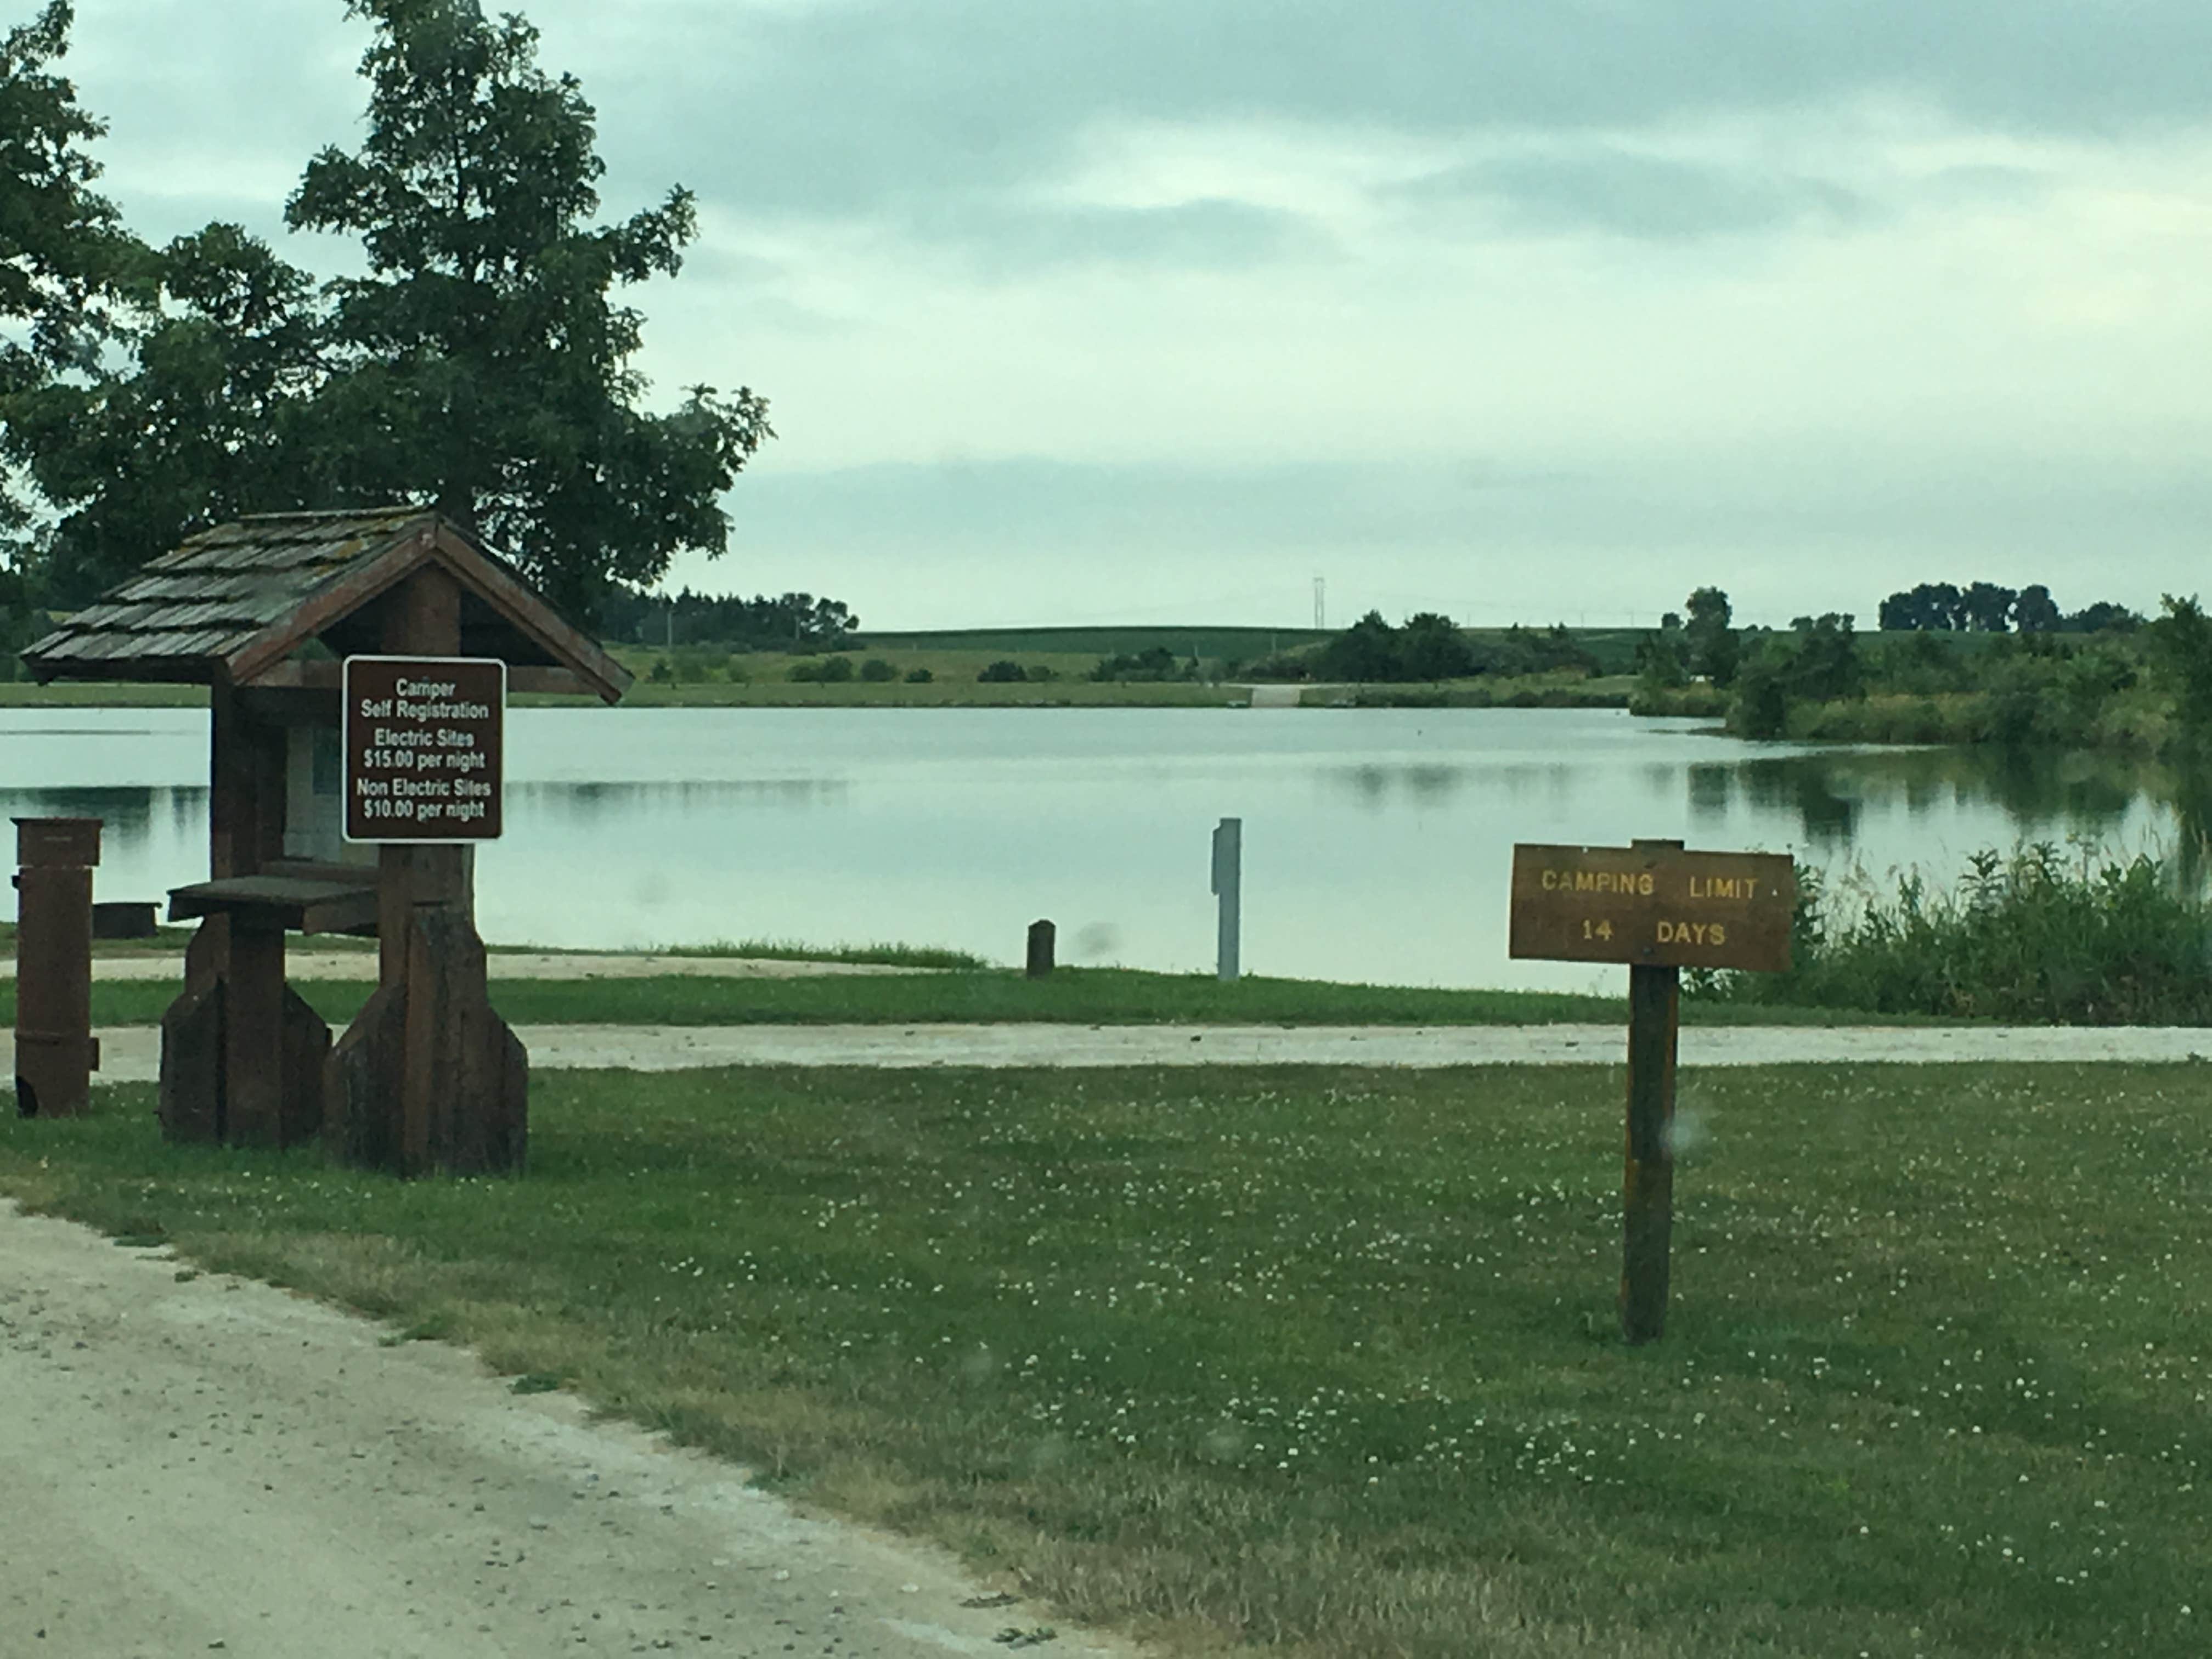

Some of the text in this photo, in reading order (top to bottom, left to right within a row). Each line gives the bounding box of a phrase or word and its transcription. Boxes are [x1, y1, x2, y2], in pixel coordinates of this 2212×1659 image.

[396, 678, 456, 700] Camper
[361, 699, 489, 722] Self Registration
[375, 729, 475, 747] Electric Sites
[364, 749, 486, 772] $15.00 per night
[357, 778, 492, 796] Non Electric Sites
[364, 799, 484, 822] $10.00 per night
[1542, 870, 1758, 899] CAMPING LIMIT
[1583, 920, 1726, 945] 14 DAYS
